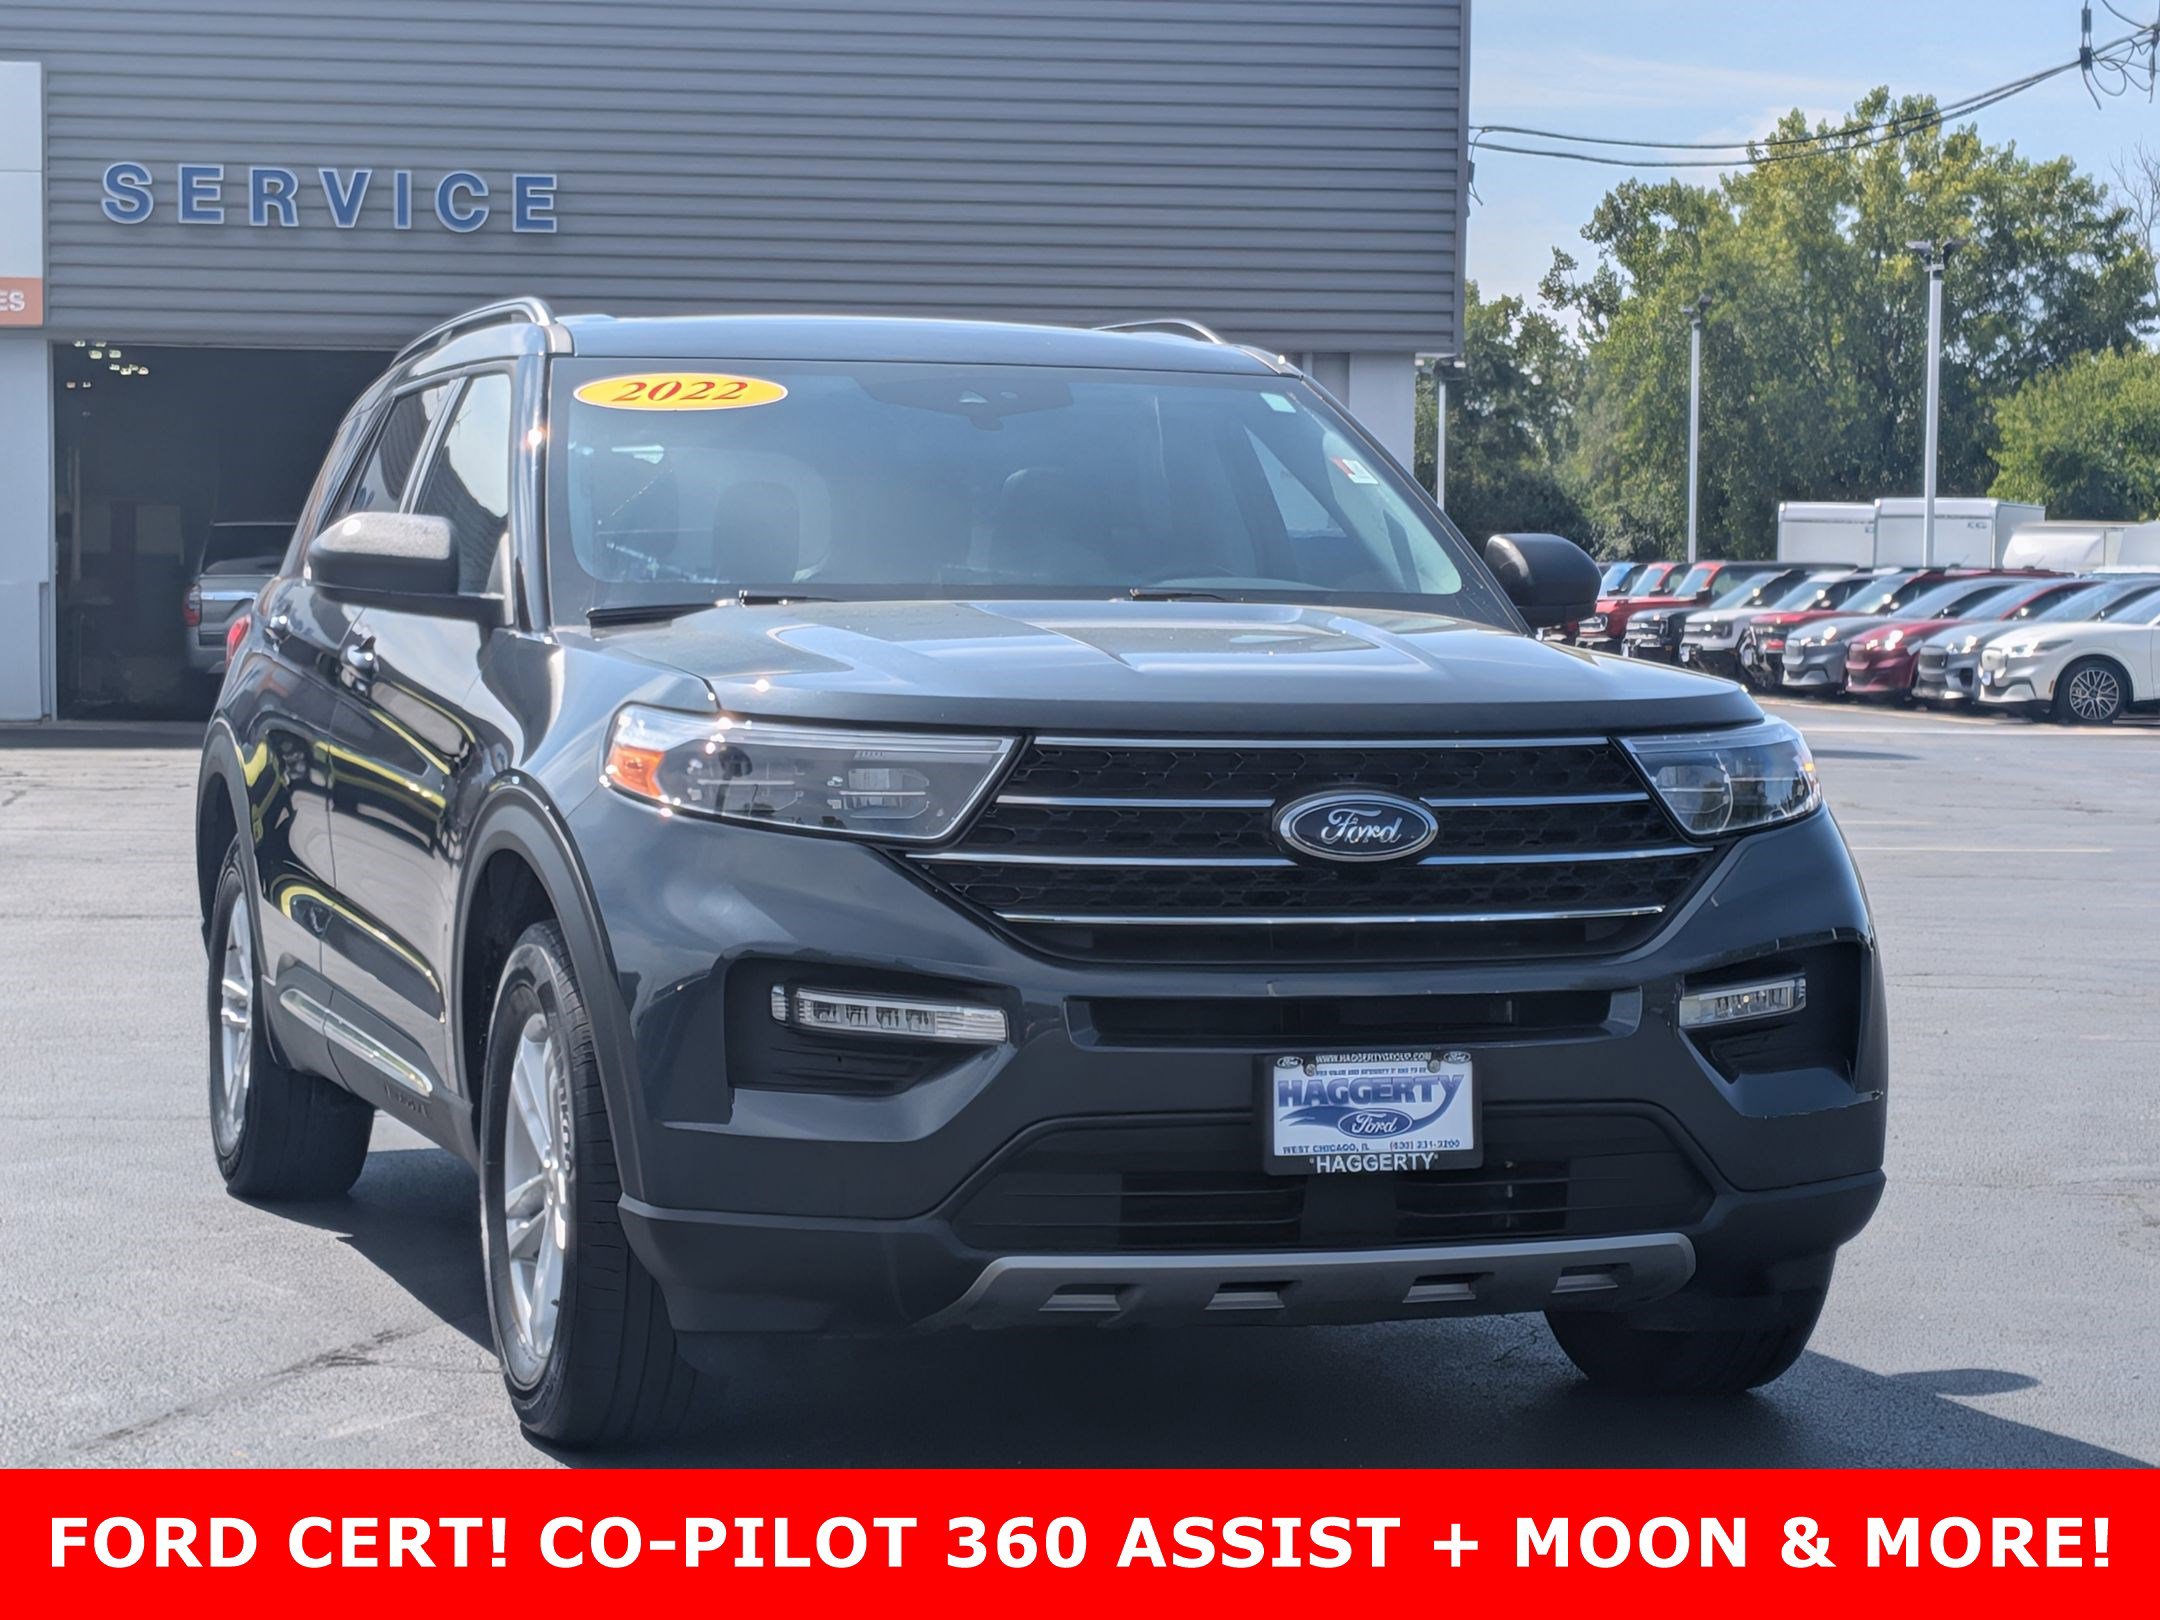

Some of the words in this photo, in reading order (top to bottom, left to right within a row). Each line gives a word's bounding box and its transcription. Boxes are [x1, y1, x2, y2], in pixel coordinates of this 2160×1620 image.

[101, 161, 557, 234] SERVICE
[611, 380, 749, 402] 2022
[1320, 808, 1403, 845] Ford
[1277, 1074, 1465, 1108] HAGGERTY
[1351, 1113, 1397, 1134] Ford
[1316, 1152, 1435, 1174] HAGGERTY
